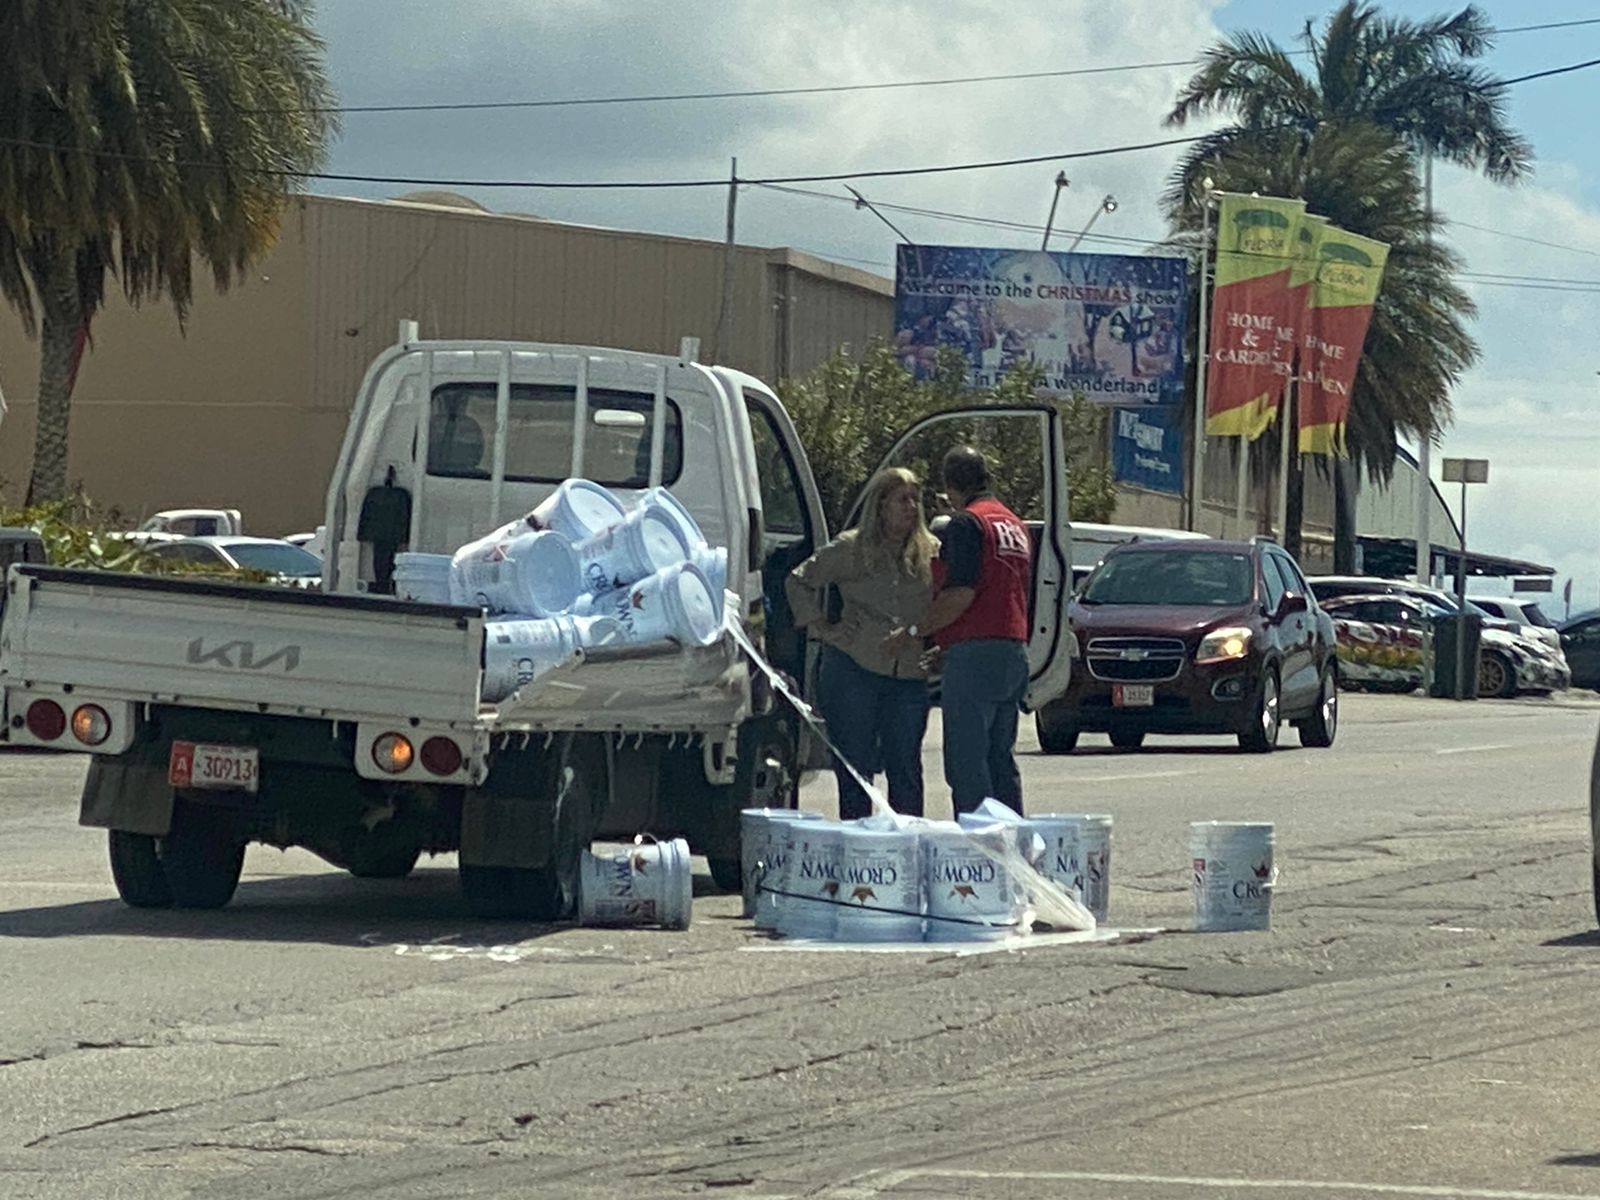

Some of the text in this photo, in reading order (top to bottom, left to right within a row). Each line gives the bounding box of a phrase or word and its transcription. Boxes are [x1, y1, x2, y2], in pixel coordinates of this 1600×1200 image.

[905, 281, 980, 296] Wecome
[985, 283, 1001, 297] to
[1005, 282, 1033, 298] the
[1037, 284, 1132, 304] CHRISTMAS
[1241, 329, 1260, 348] &
[1305, 334, 1345, 360] HME
[1055, 377, 1158, 394] wonderland
[187, 637, 300, 672] KIA
[177, 757, 188, 771] A
[203, 755, 253, 781] 30913
